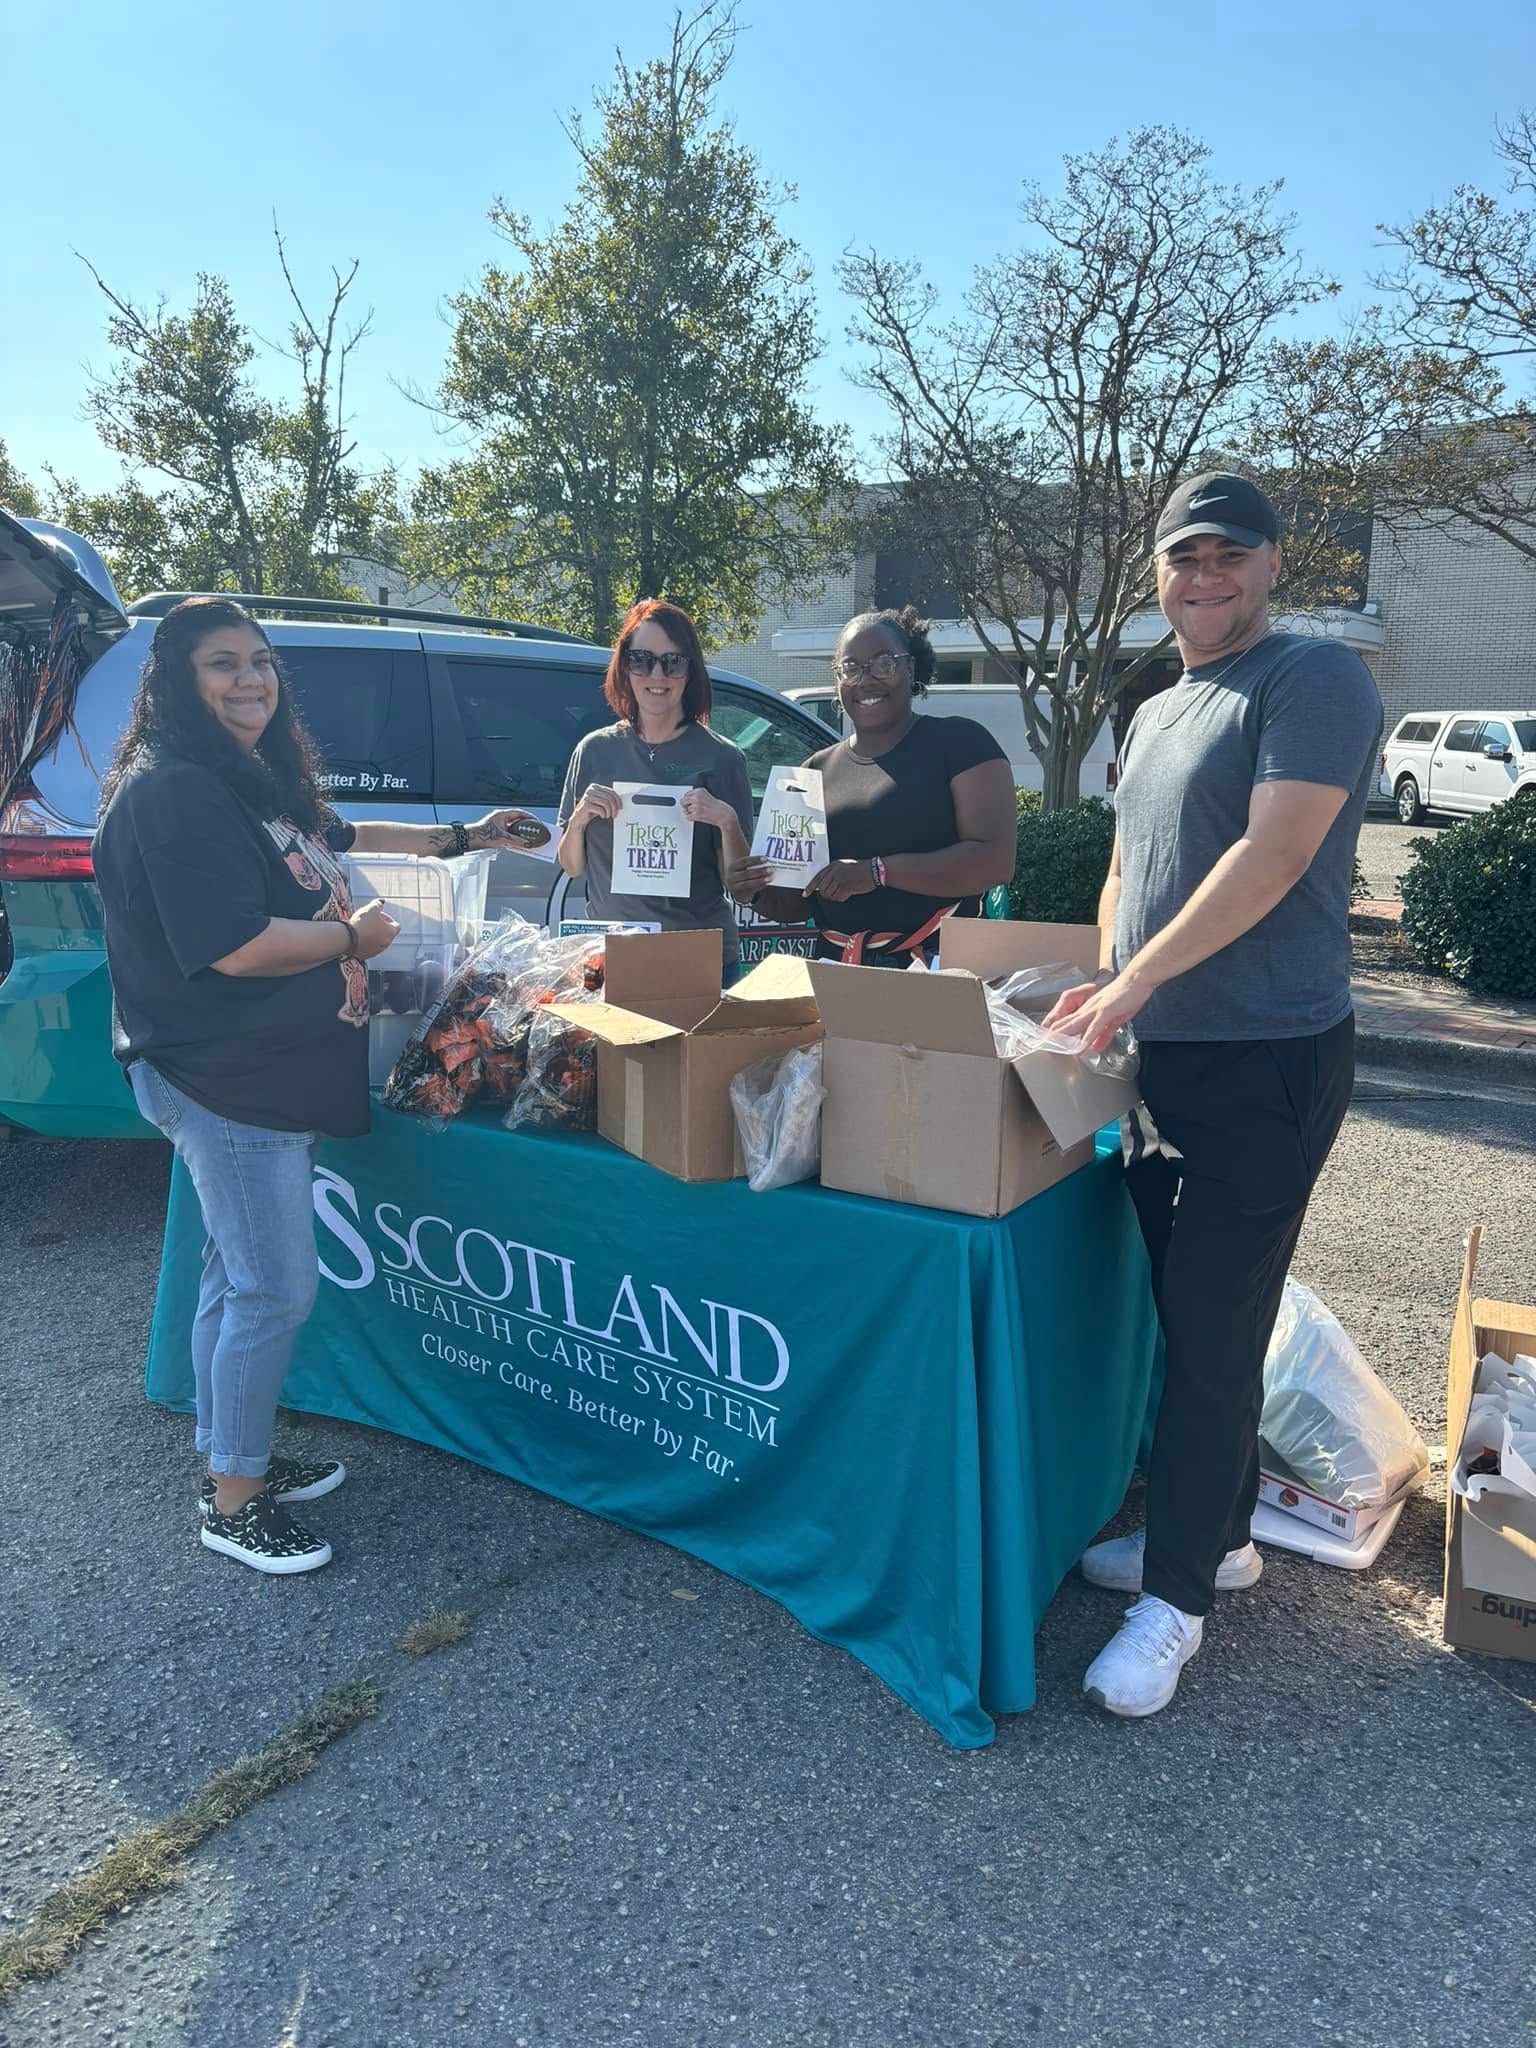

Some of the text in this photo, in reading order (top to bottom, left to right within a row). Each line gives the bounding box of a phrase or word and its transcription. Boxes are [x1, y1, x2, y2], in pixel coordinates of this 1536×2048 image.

[359, 773, 379, 791] By
[382, 773, 409, 789] Far.
[626, 821, 678, 849] TRICK
[770, 808, 816, 839] TRICK
[626, 848, 678, 870] TREAT
[765, 836, 817, 862] TREAT
[738, 937, 818, 962] ARE SYST
[374, 1203, 790, 1392] SCOTLAND
[384, 1279, 779, 1447] HEALTH CARE SYSTEM
[422, 1333, 741, 1483] Closer Care. Better by Far.
